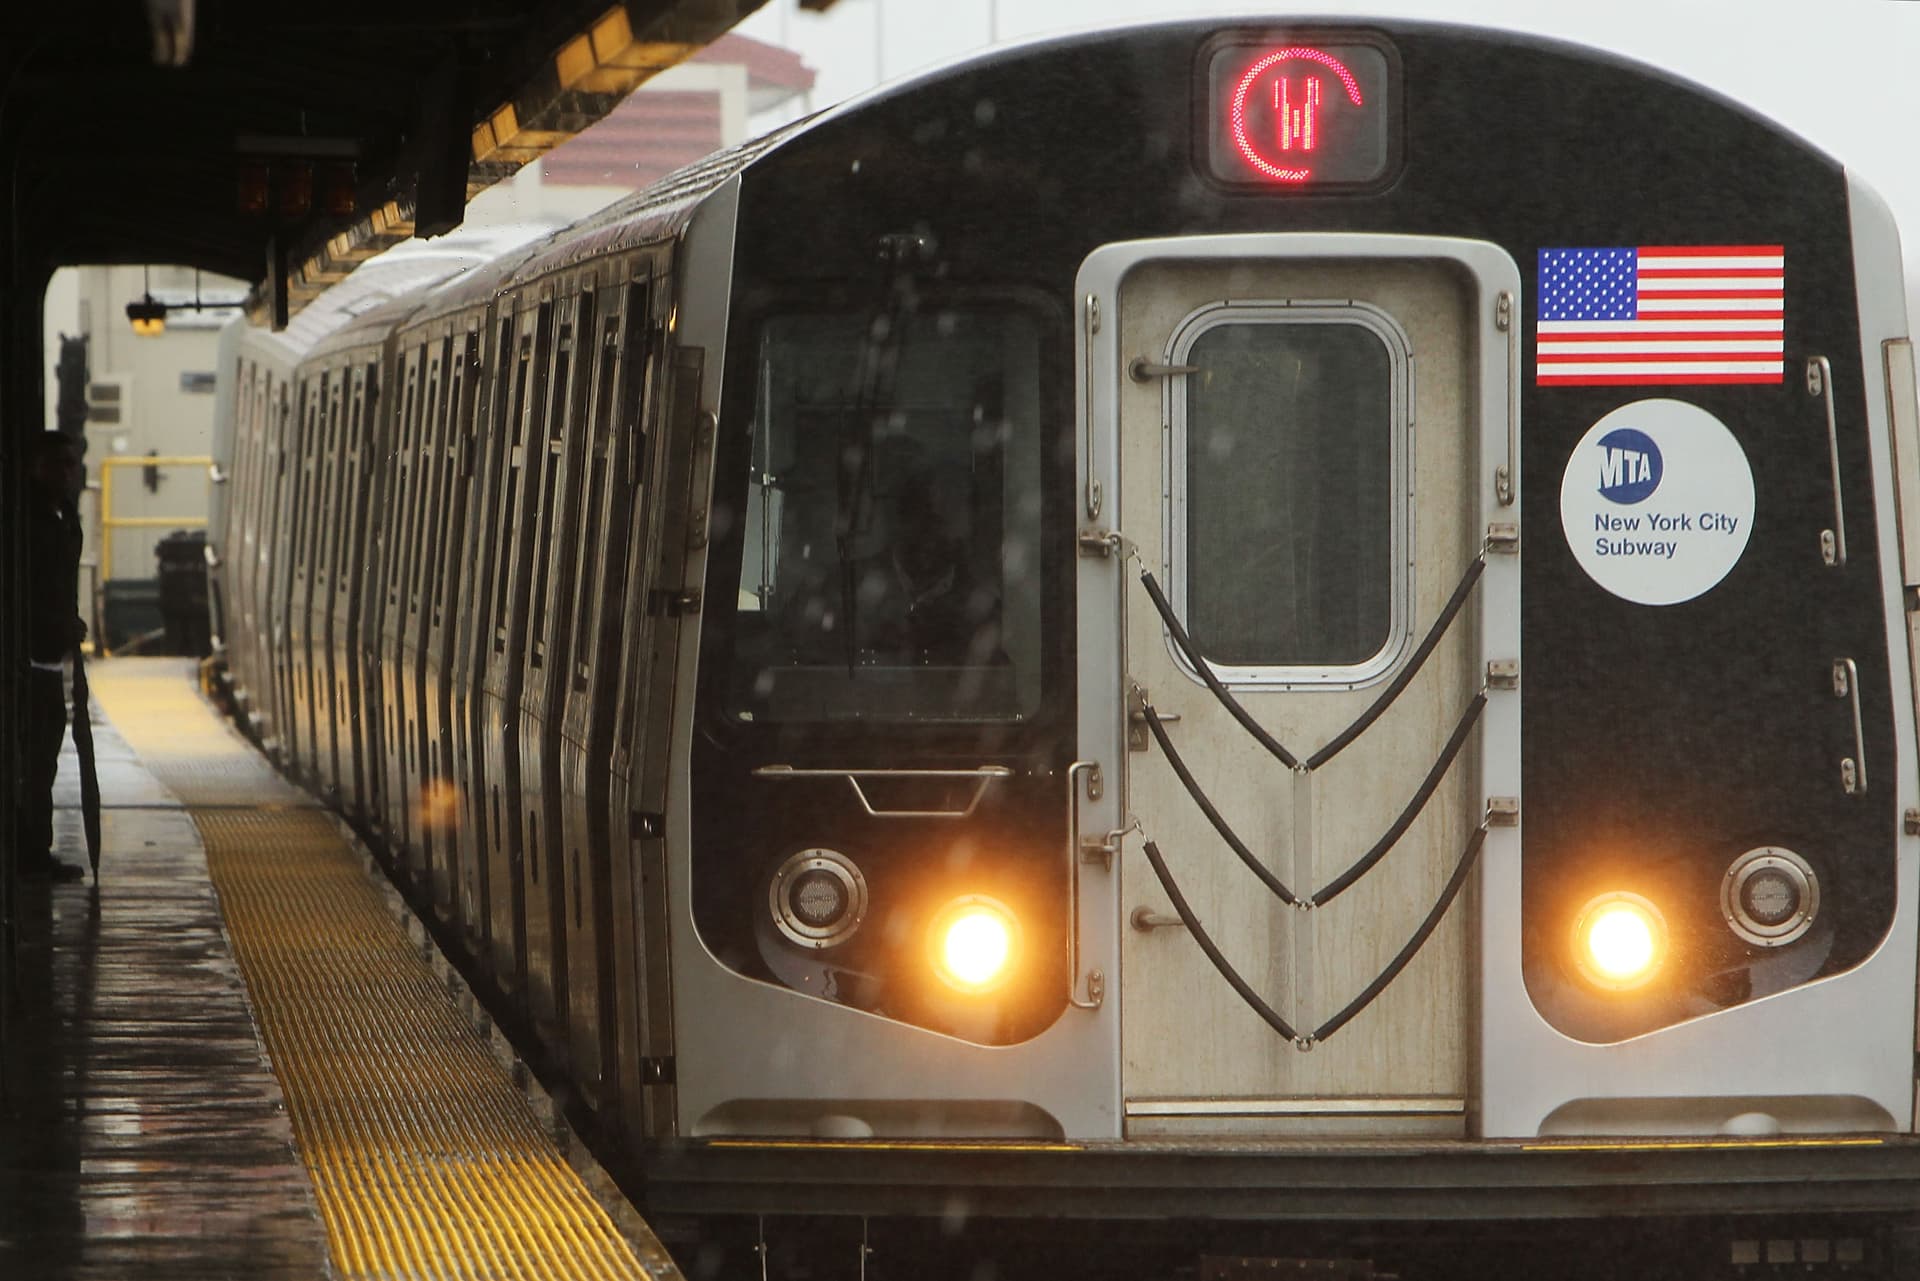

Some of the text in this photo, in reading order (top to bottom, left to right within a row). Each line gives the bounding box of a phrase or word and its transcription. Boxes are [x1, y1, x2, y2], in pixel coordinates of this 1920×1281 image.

[1598, 444, 1652, 490] MTA
[1595, 513, 1738, 535] New York City
[1595, 537, 1678, 560] Subway
